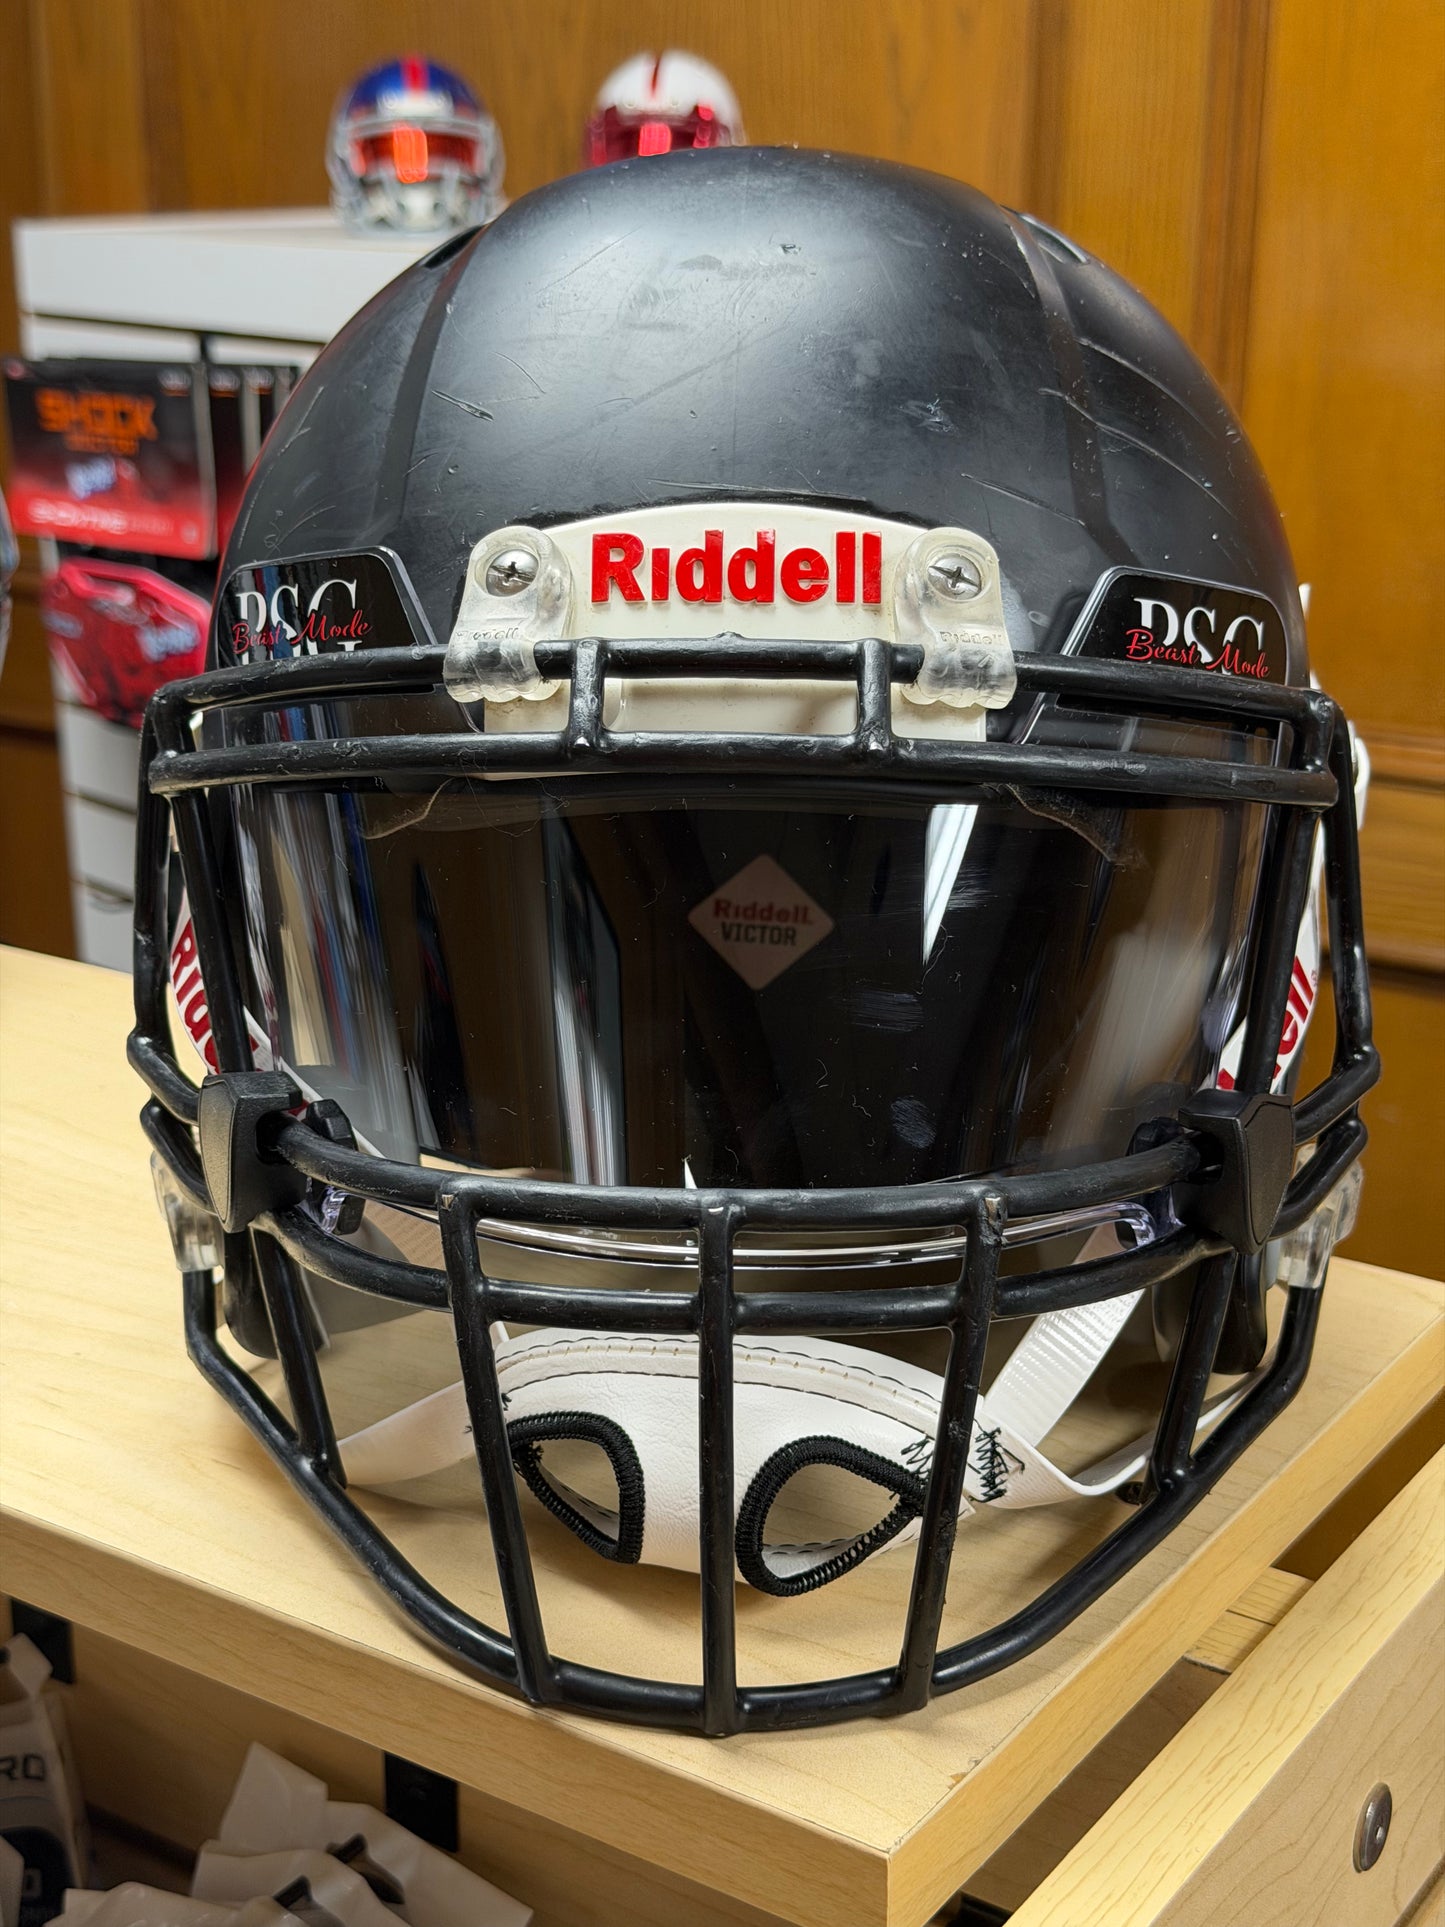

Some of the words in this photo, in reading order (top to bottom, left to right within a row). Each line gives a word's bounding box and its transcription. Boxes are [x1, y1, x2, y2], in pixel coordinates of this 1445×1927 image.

[591, 529, 882, 605] Riddell
[232, 622, 285, 655] Beast
[290, 609, 373, 646] Mode
[1125, 628, 1199, 661] Beast
[1206, 643, 1271, 679] Mode
[714, 898, 812, 924] Riddell
[721, 921, 797, 946] VICTOR
